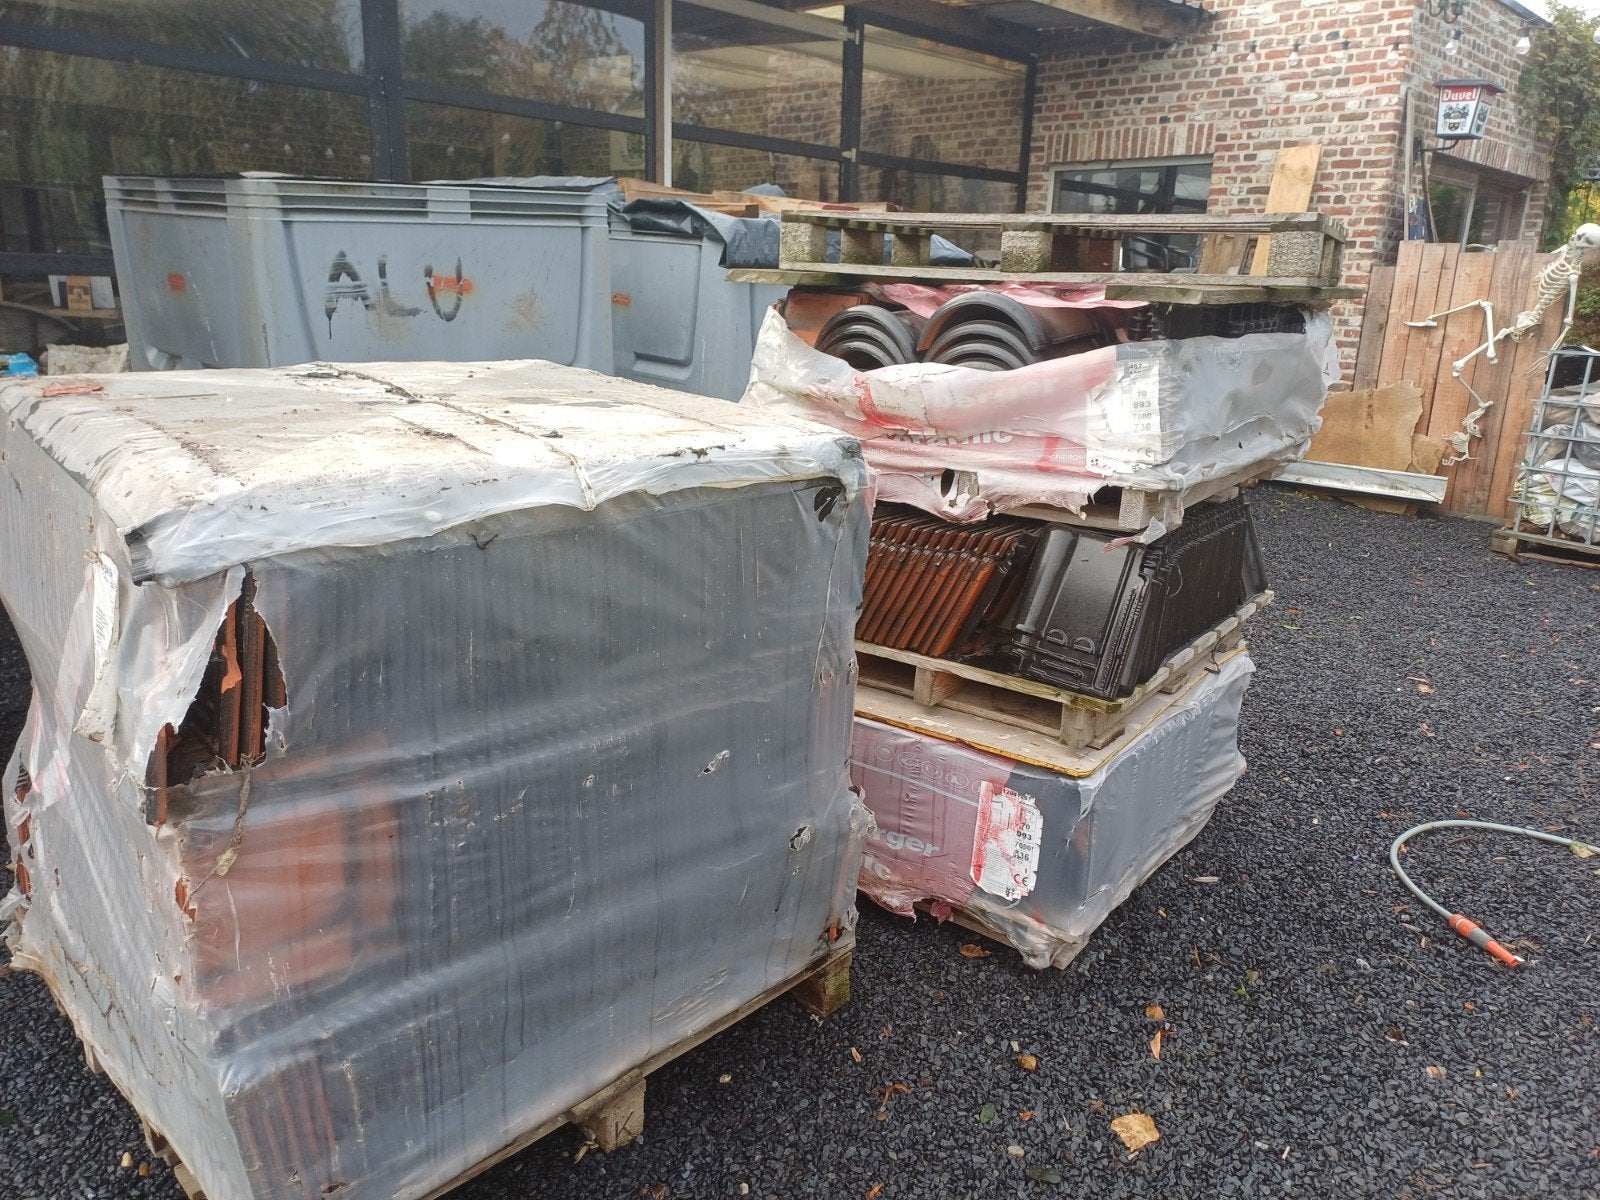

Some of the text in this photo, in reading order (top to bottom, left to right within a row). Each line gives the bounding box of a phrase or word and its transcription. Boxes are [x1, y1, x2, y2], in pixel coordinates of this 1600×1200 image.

[1442, 88, 1477, 101] Duvel
[324, 249, 464, 326] ALU
[1132, 400, 1152, 409] 993
[1133, 422, 1152, 432] 736
